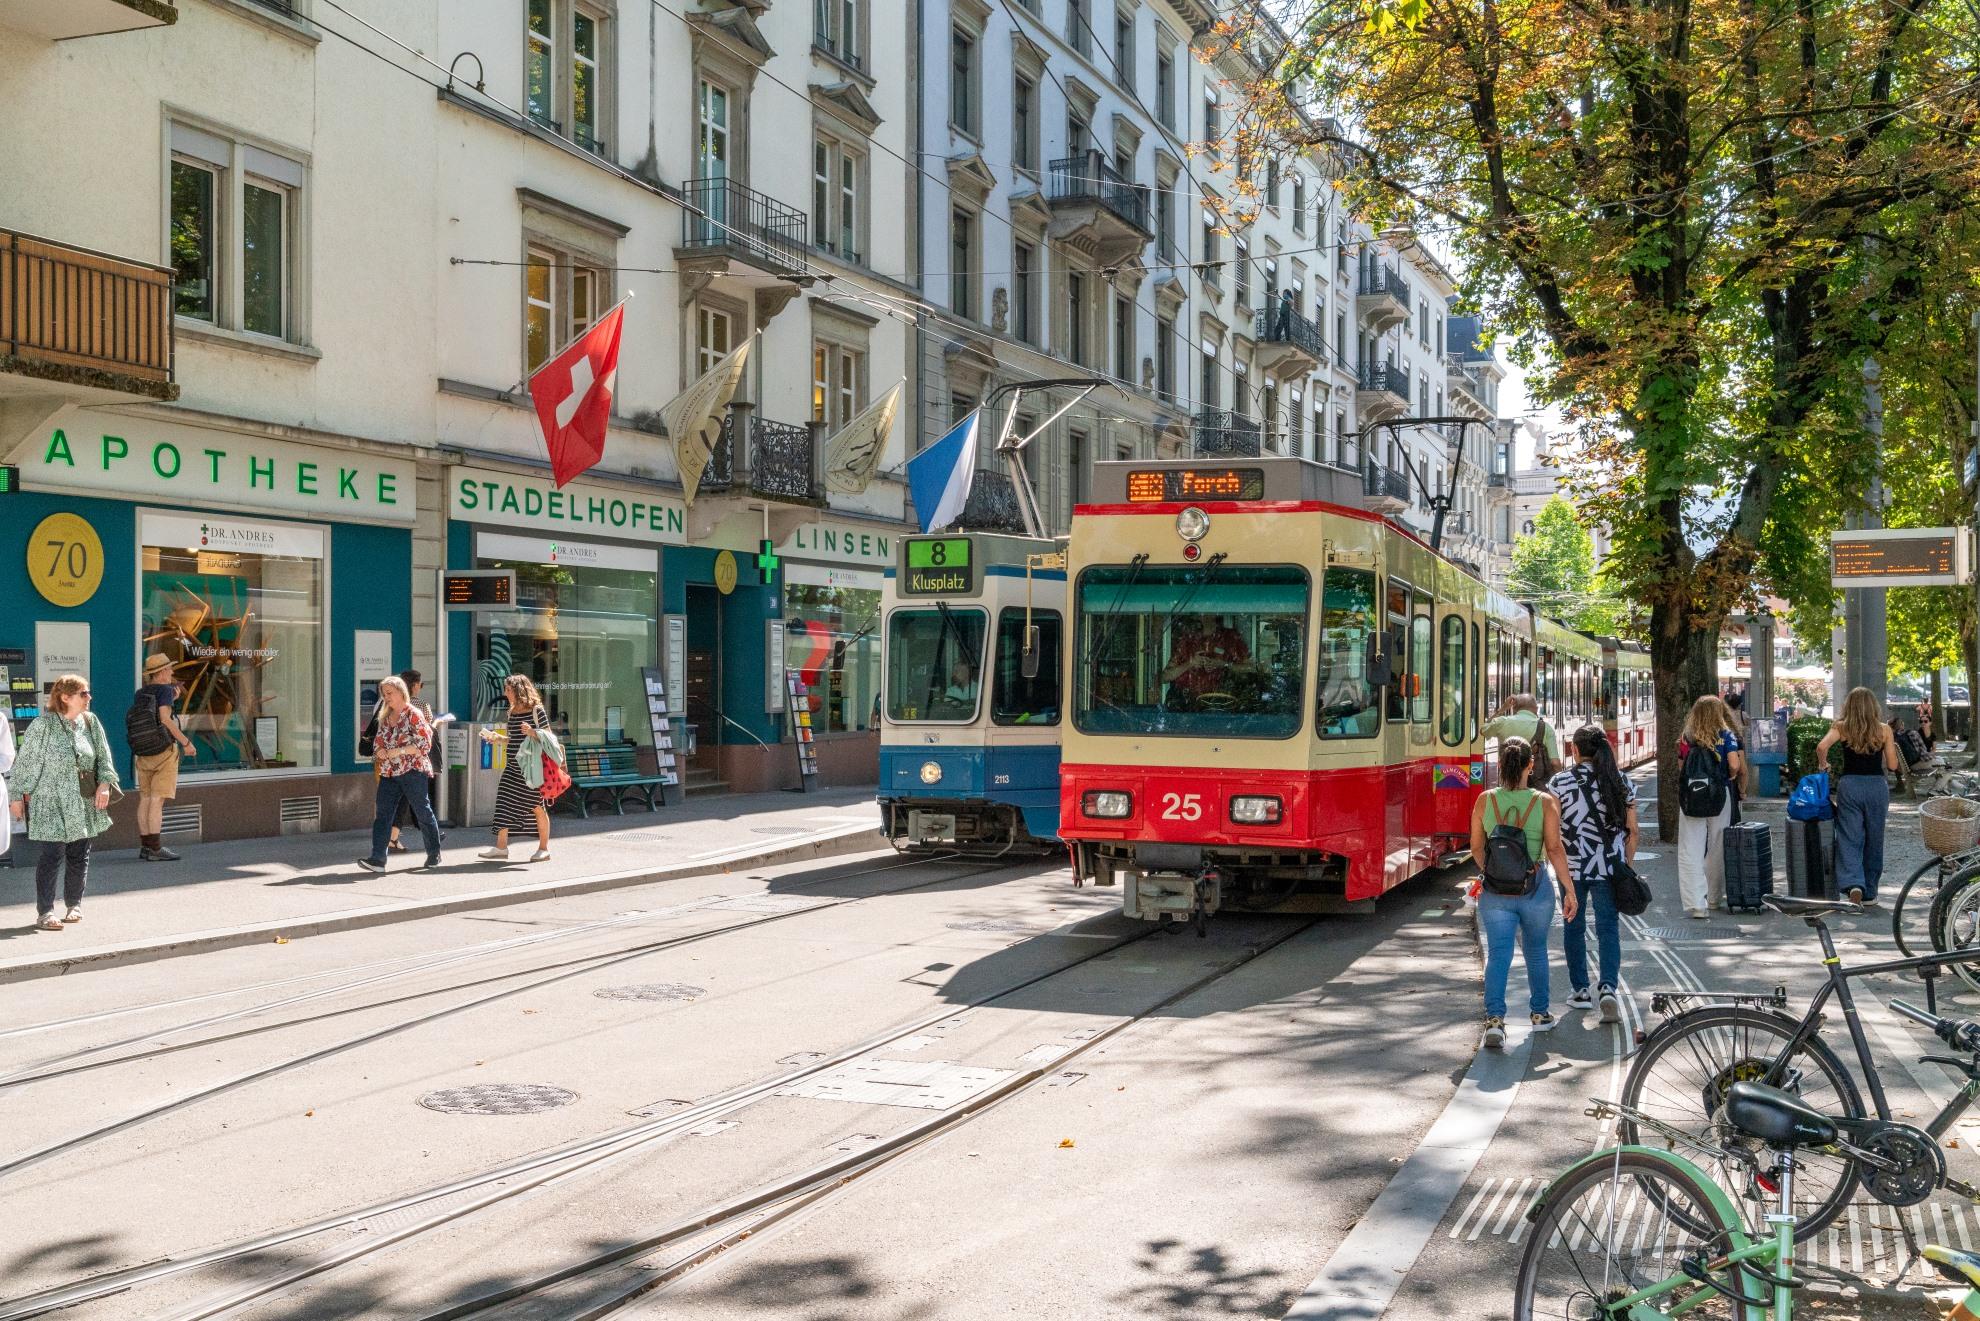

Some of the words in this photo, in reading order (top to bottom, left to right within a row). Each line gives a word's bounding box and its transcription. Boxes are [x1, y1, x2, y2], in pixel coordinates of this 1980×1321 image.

[45, 429, 397, 504] APOTHEKE
[1183, 471, 1240, 494] Forch
[459, 479, 683, 533] STADELHOFEN
[229, 529, 274, 542] ANDRES
[796, 528, 888, 557] LINSEN
[47, 541, 87, 579] 70
[931, 542, 947, 565] 8
[912, 573, 965, 593] Klusplatz
[191, 646, 217, 657] Wieder
[219, 648, 230, 657] ein
[231, 648, 253, 659] wenig
[253, 647, 280, 657] mobiler.
[994, 775, 1010, 784] 2113
[1161, 792, 1202, 822] 25
